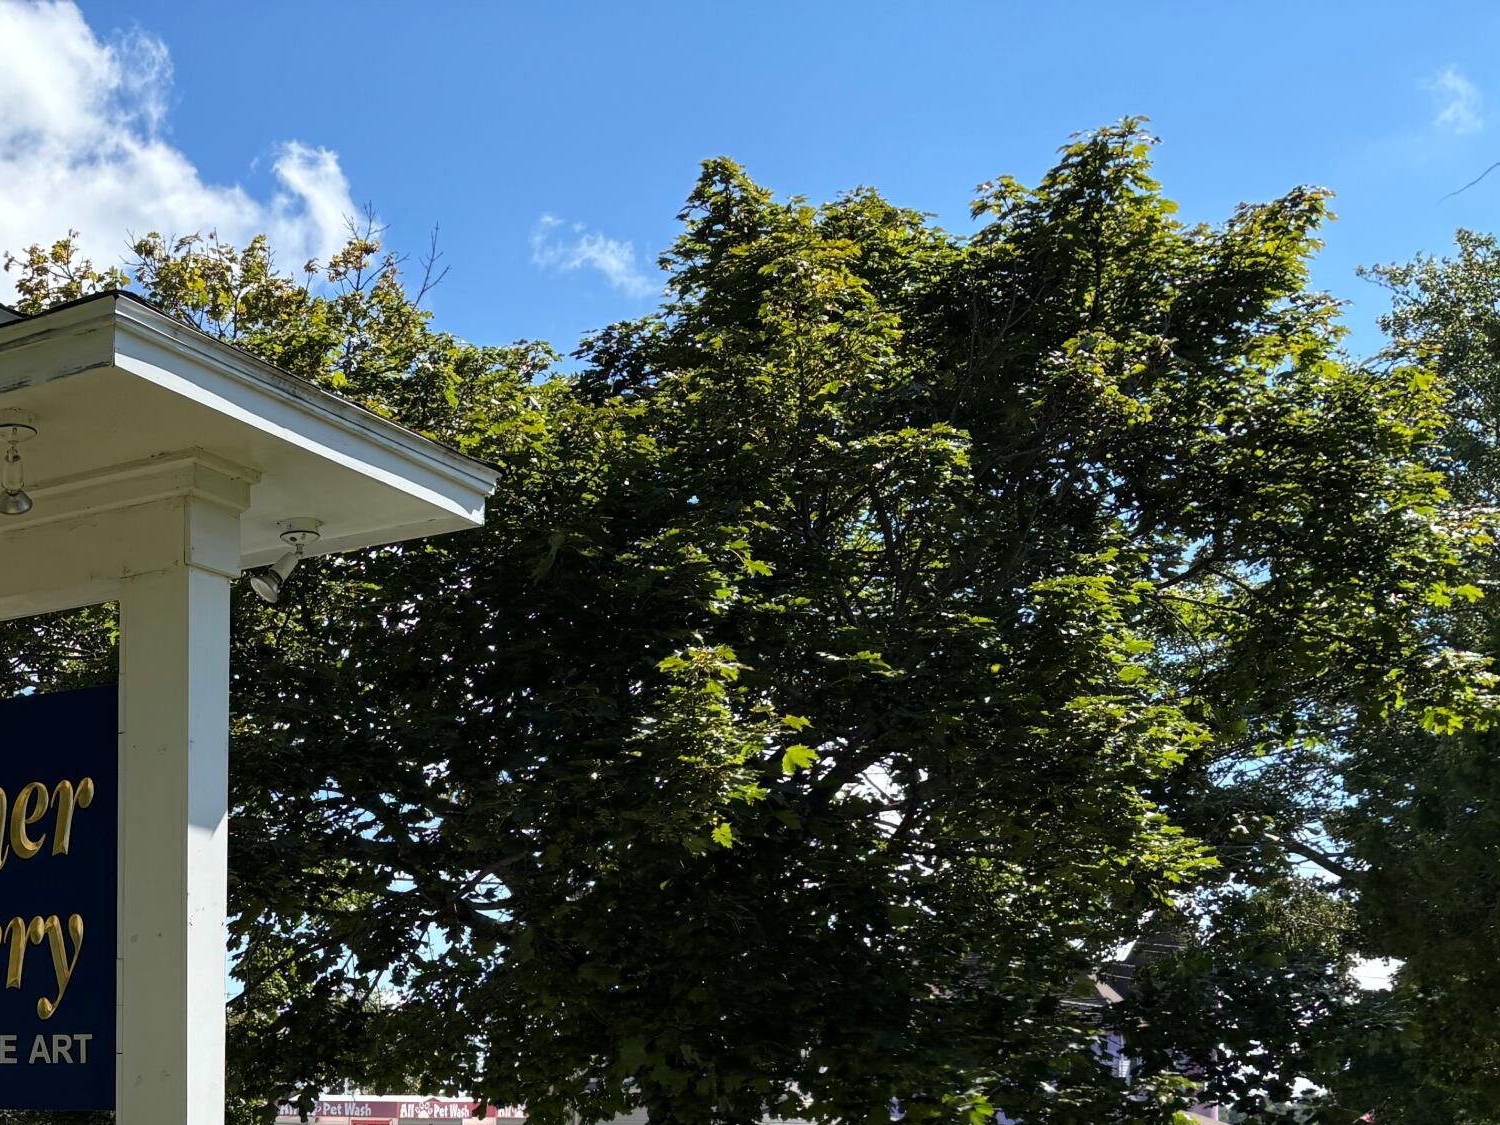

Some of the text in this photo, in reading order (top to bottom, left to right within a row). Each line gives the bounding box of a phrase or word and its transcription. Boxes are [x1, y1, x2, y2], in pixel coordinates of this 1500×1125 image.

[28, 1033, 93, 1064] ART
[322, 1103, 342, 1116] Pet
[344, 1102, 372, 1117] Wash
[399, 1103, 470, 1118] All Pet Wash
